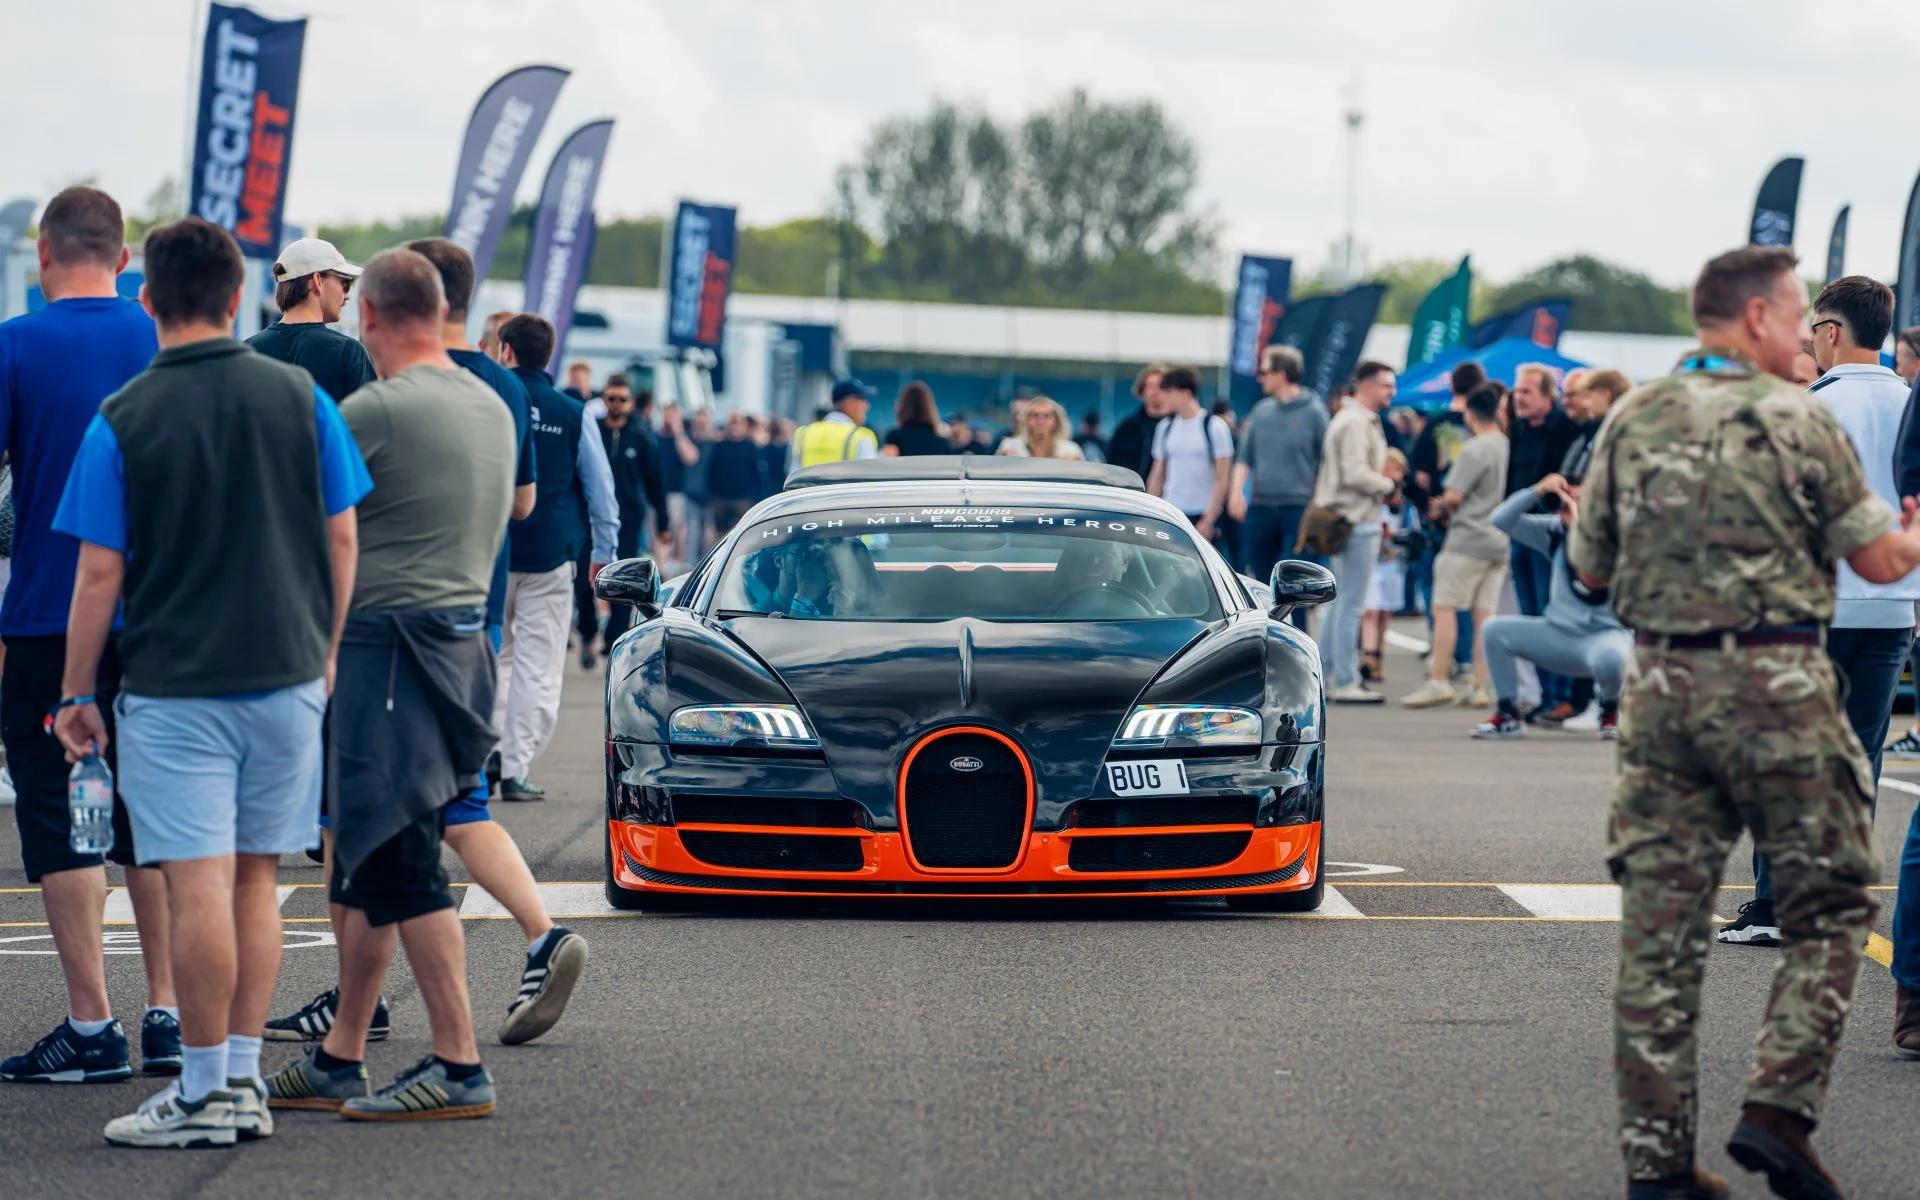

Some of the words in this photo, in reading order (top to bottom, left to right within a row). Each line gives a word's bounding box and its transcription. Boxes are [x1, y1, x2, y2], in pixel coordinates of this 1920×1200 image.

[200, 18, 259, 233] SECRET
[473, 97, 534, 193] HERE
[235, 90, 290, 246] MEET
[541, 424, 562, 435] CARS
[920, 508, 1012, 516] NONCOURS
[762, 519, 844, 539] HIGH
[866, 515, 1015, 525] MILEAGE
[1038, 517, 1171, 541] HEROES
[1110, 764, 1162, 791] BUG
